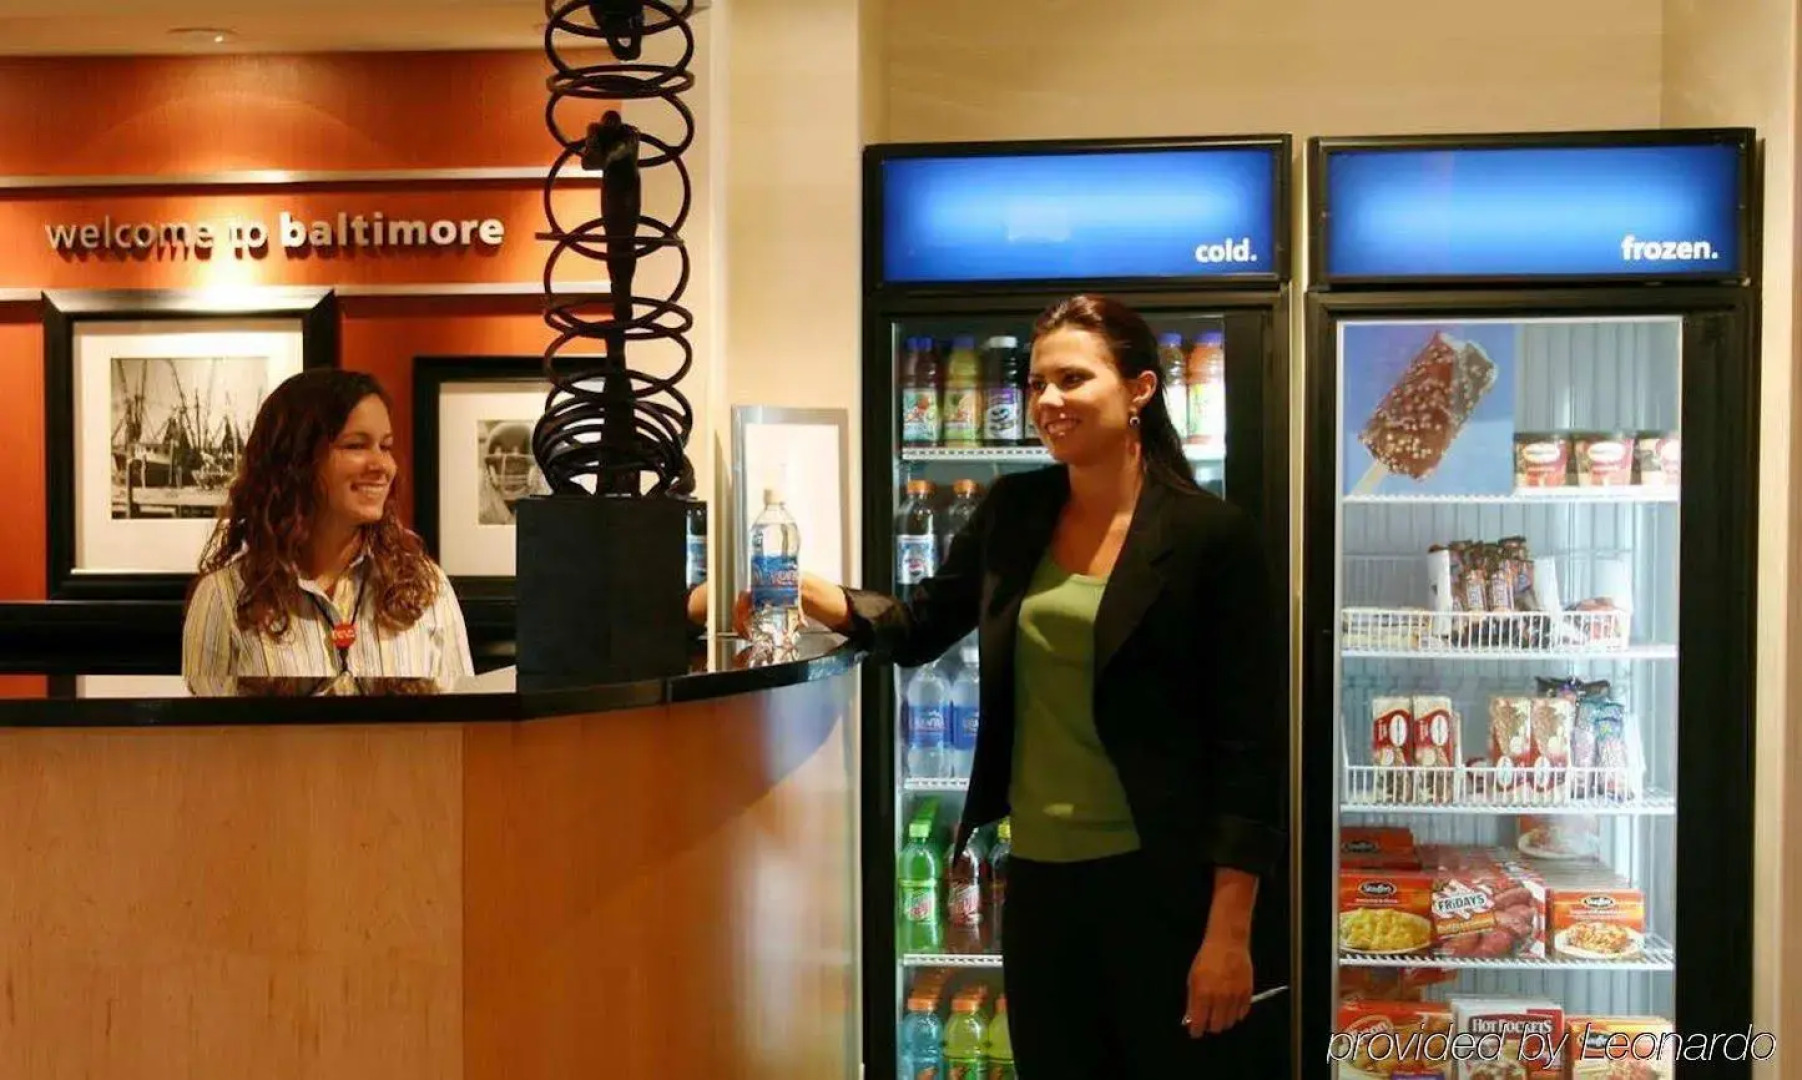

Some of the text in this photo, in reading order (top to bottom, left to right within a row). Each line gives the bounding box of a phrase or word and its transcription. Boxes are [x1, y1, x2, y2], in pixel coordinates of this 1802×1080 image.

[44, 211, 505, 249] welcome to baltimore
[1195, 236, 1258, 263] cold.
[1620, 234, 1719, 260] frozen.
